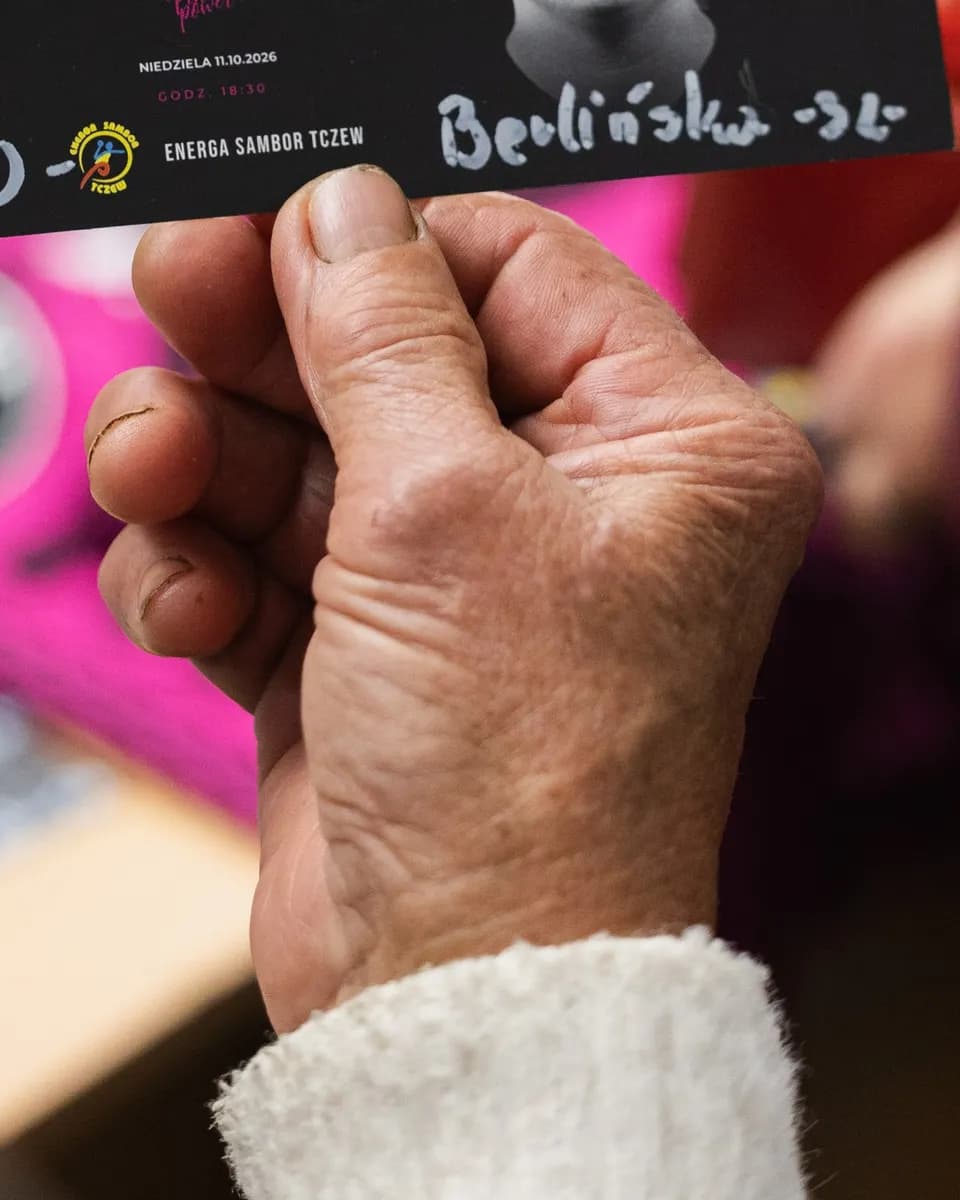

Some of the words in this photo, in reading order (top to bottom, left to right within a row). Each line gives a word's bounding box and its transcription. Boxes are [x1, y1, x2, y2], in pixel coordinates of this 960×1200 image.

[139, 57, 212, 73] NIEDZIELA
[214, 51, 278, 67] 11.10.2026
[220, 82, 266, 97] 18:30
[164, 138, 230, 162] ENERGA
[235, 131, 304, 156] SAMBOR
[308, 126, 364, 149] TCZEW
